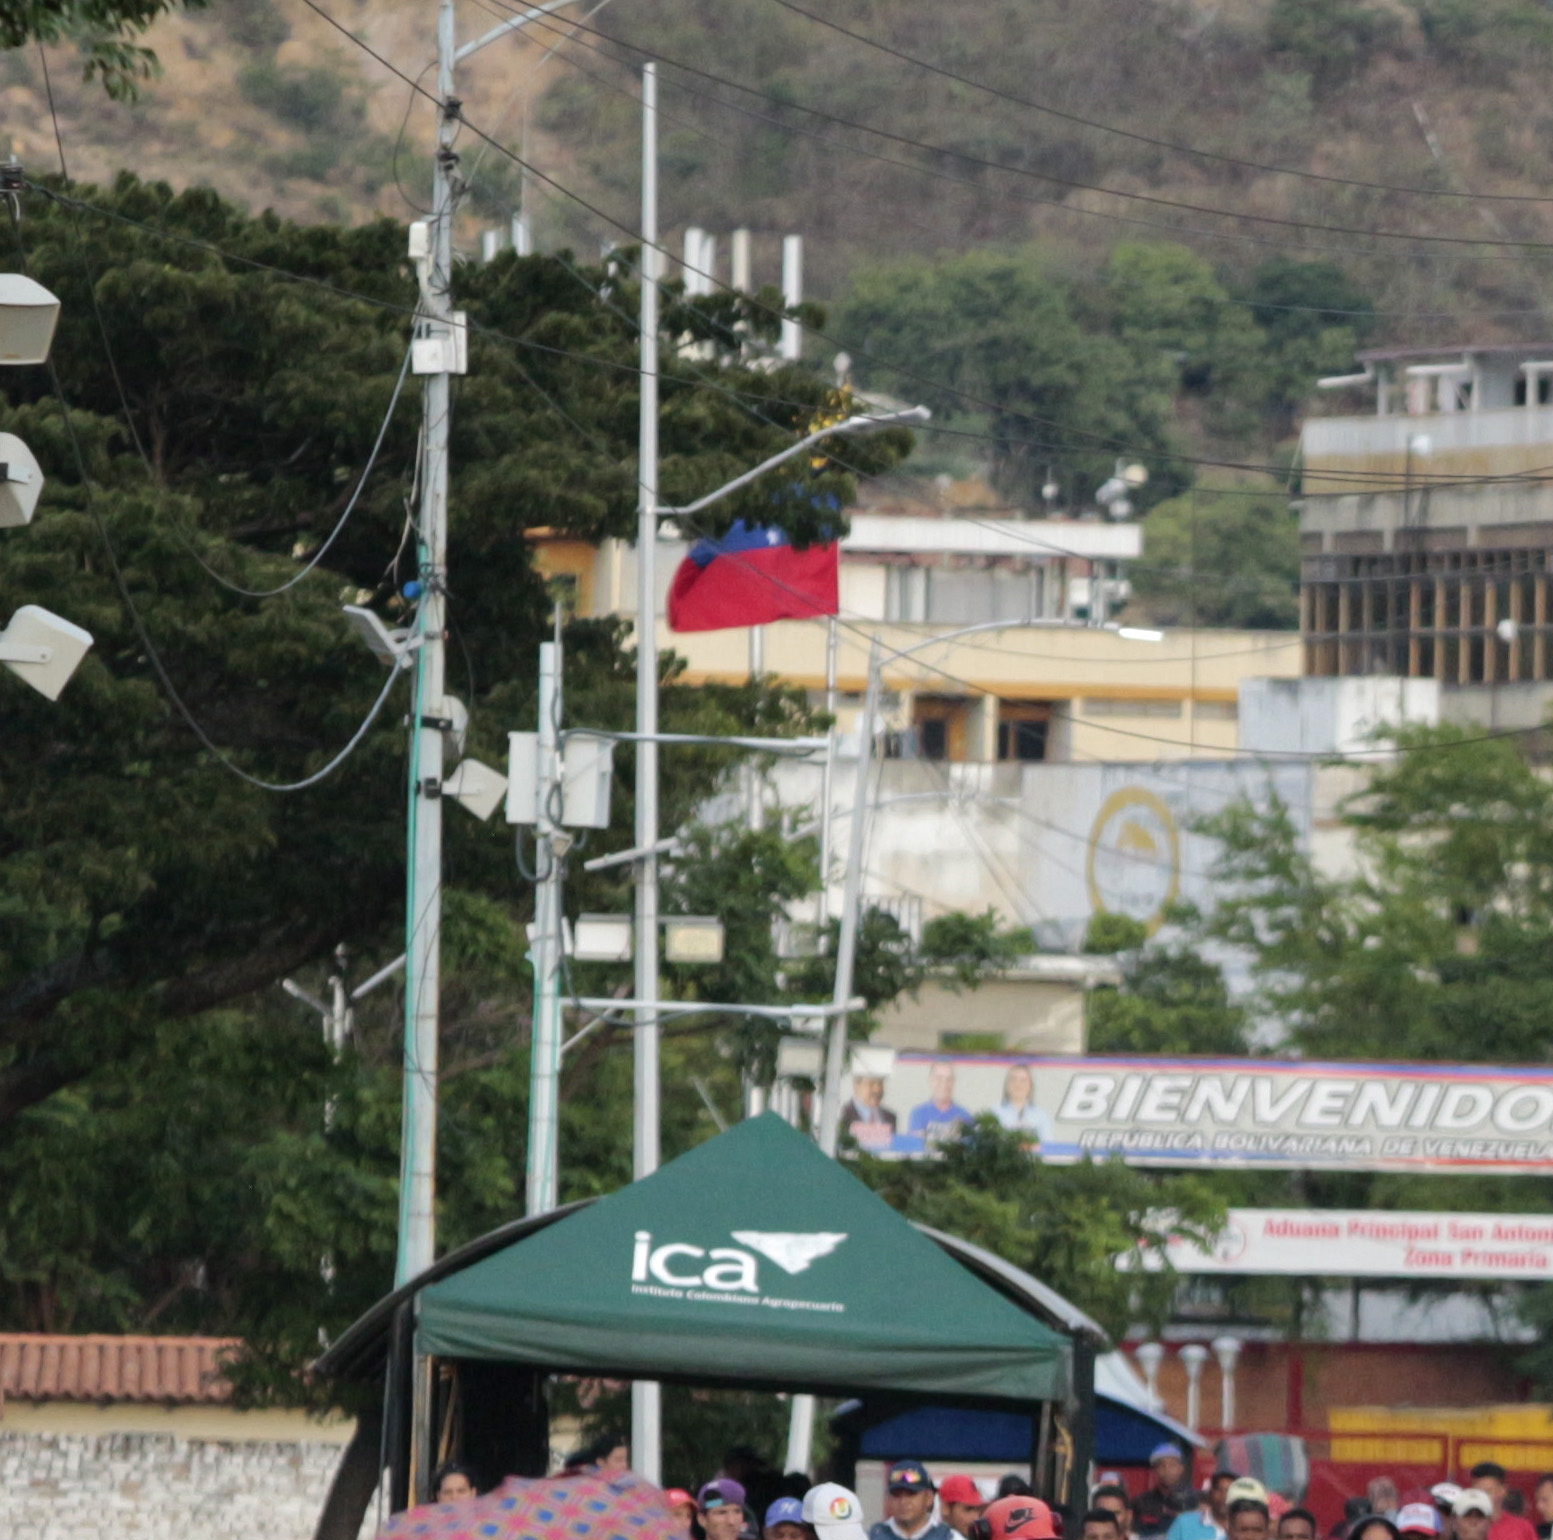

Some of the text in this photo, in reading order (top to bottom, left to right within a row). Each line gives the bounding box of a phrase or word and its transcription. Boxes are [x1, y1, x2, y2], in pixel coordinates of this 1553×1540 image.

[1381, 1136, 1418, 1156] DE
[1263, 1218, 1341, 1239] Aduana
[1347, 1219, 1439, 1242] Principal
[1449, 1222, 1484, 1240] San
[632, 1230, 759, 1293] ica
[1404, 1249, 1549, 1269] Zona Primaria
[632, 1283, 844, 1312] Instituto Colombiano Agropecuario
